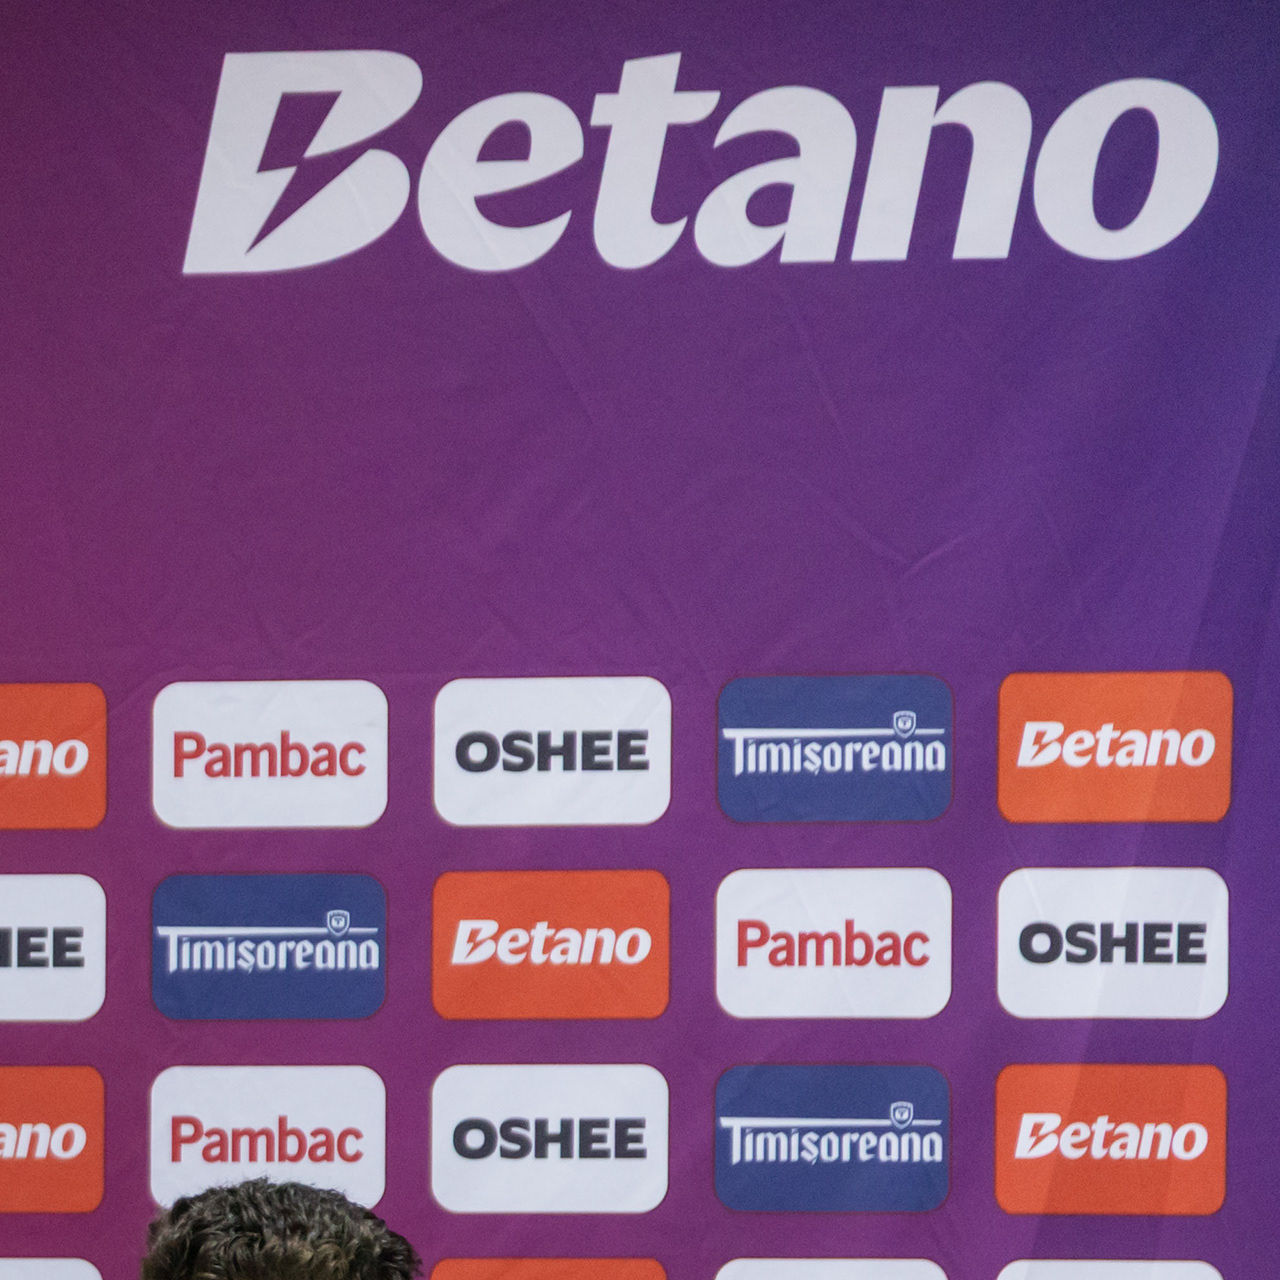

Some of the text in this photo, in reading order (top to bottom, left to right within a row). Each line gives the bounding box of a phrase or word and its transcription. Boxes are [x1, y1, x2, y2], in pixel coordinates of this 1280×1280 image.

[182, 48, 1220, 276] Betano
[173, 730, 366, 778] Pambac
[455, 730, 649, 774] OSHEE
[1016, 721, 1216, 768] Betano
[450, 919, 652, 966] Betano
[737, 919, 929, 968] Pambac
[1018, 922, 1207, 965] OSHEE
[170, 1115, 363, 1164] Pambac
[452, 1118, 647, 1161] OSHEE
[1013, 1112, 1209, 1161] Betano
